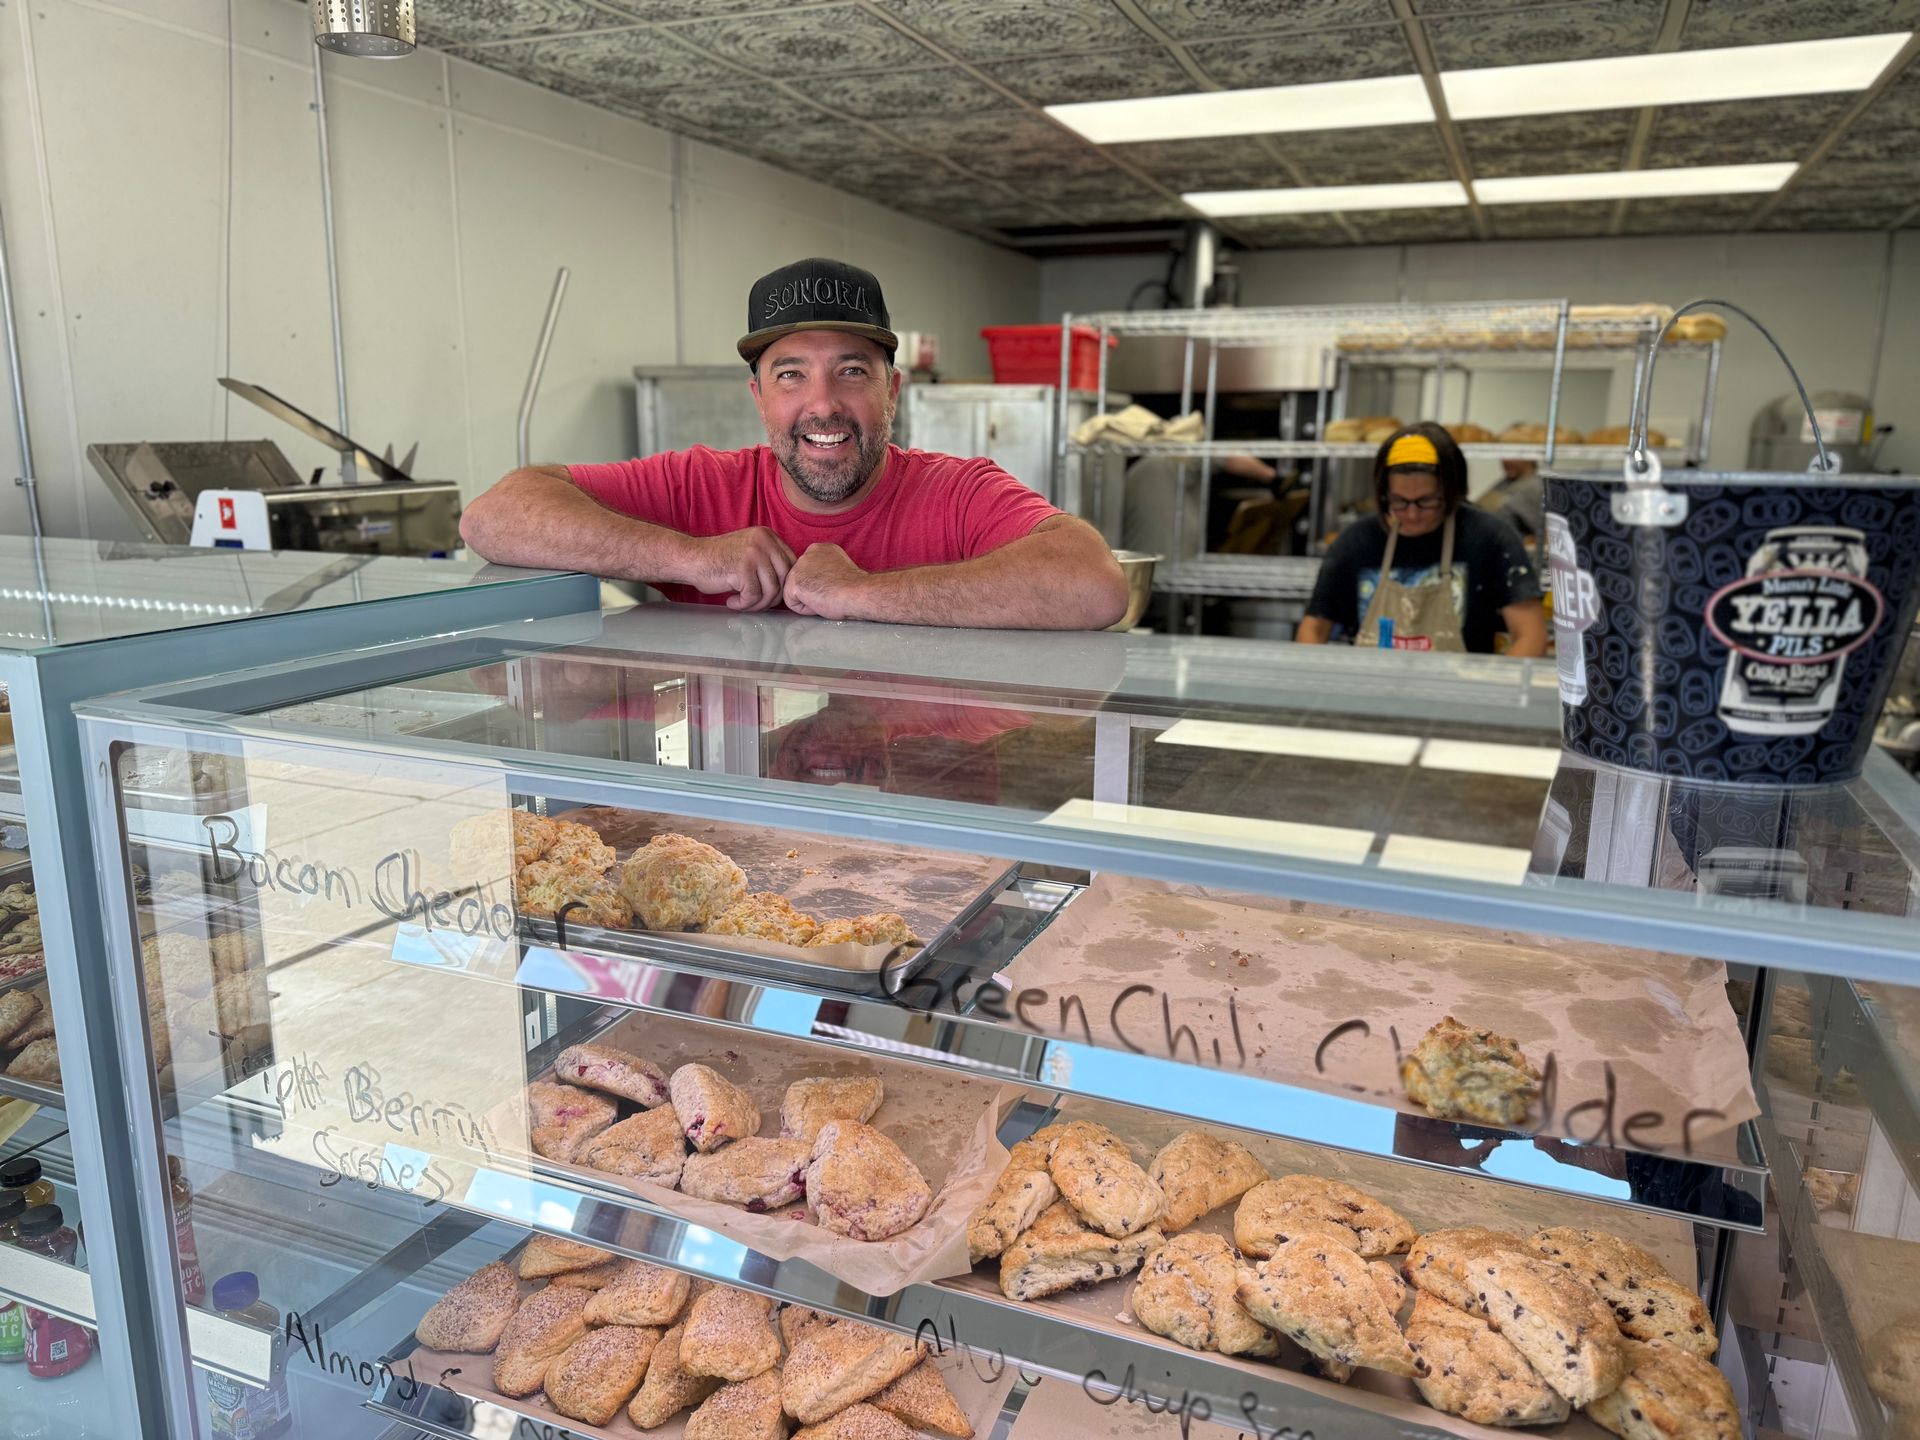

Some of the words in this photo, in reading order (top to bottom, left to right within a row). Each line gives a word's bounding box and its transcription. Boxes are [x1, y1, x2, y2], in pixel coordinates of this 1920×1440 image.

[764, 277, 873, 320] SONORA
[1730, 595, 1864, 637] YELLA
[1767, 634, 1825, 657] PILS
[202, 814, 357, 909] Bacon
[878, 940, 1094, 1048] Green
[285, 1311, 418, 1401] Almond
